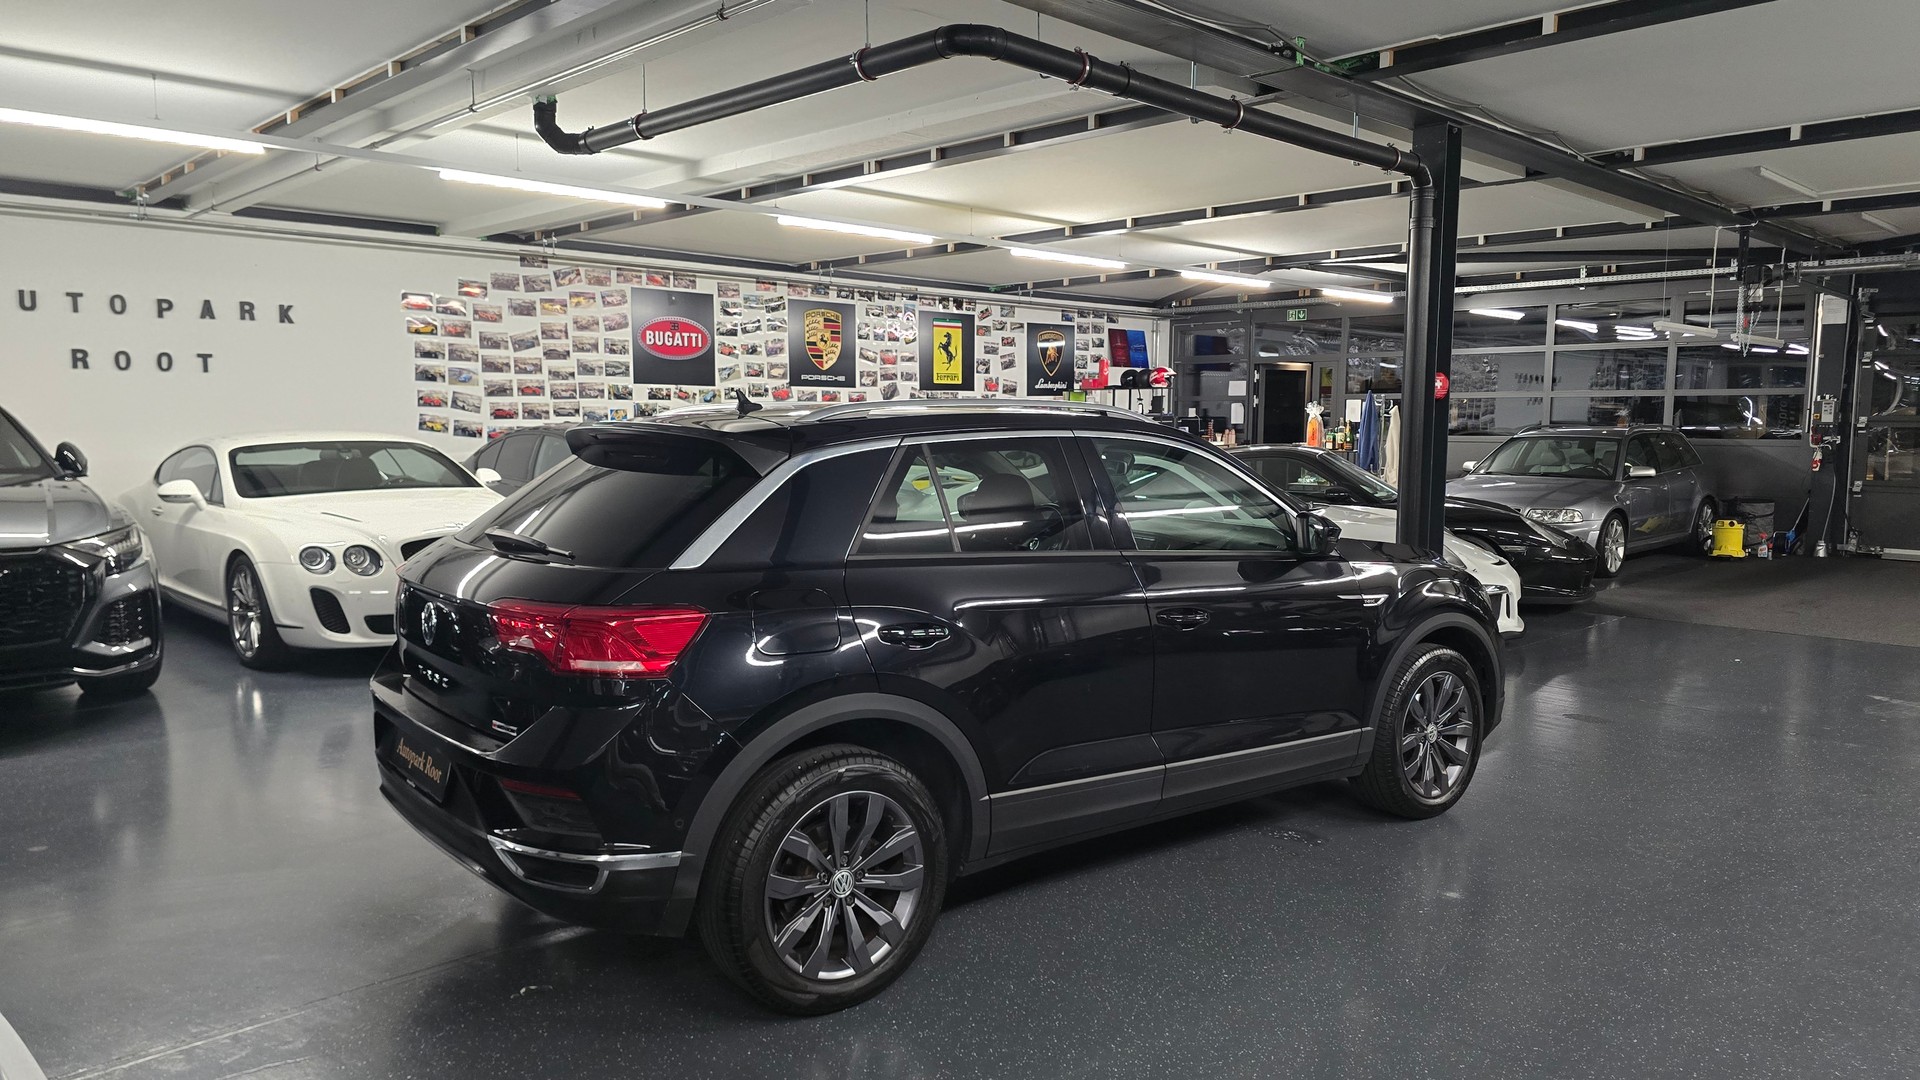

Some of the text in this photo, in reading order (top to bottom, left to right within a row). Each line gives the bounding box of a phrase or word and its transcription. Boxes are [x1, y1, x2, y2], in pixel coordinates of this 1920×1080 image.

[806, 310, 840, 321] PORSCHE
[646, 330, 703, 348] BUGATTI
[71, 348, 213, 374] ROOT
[801, 374, 846, 382] PORSCHE
[936, 372, 959, 381] Ferrari
[1034, 377, 1068, 392] Lamborghini
[396, 737, 425, 771] Autopark
